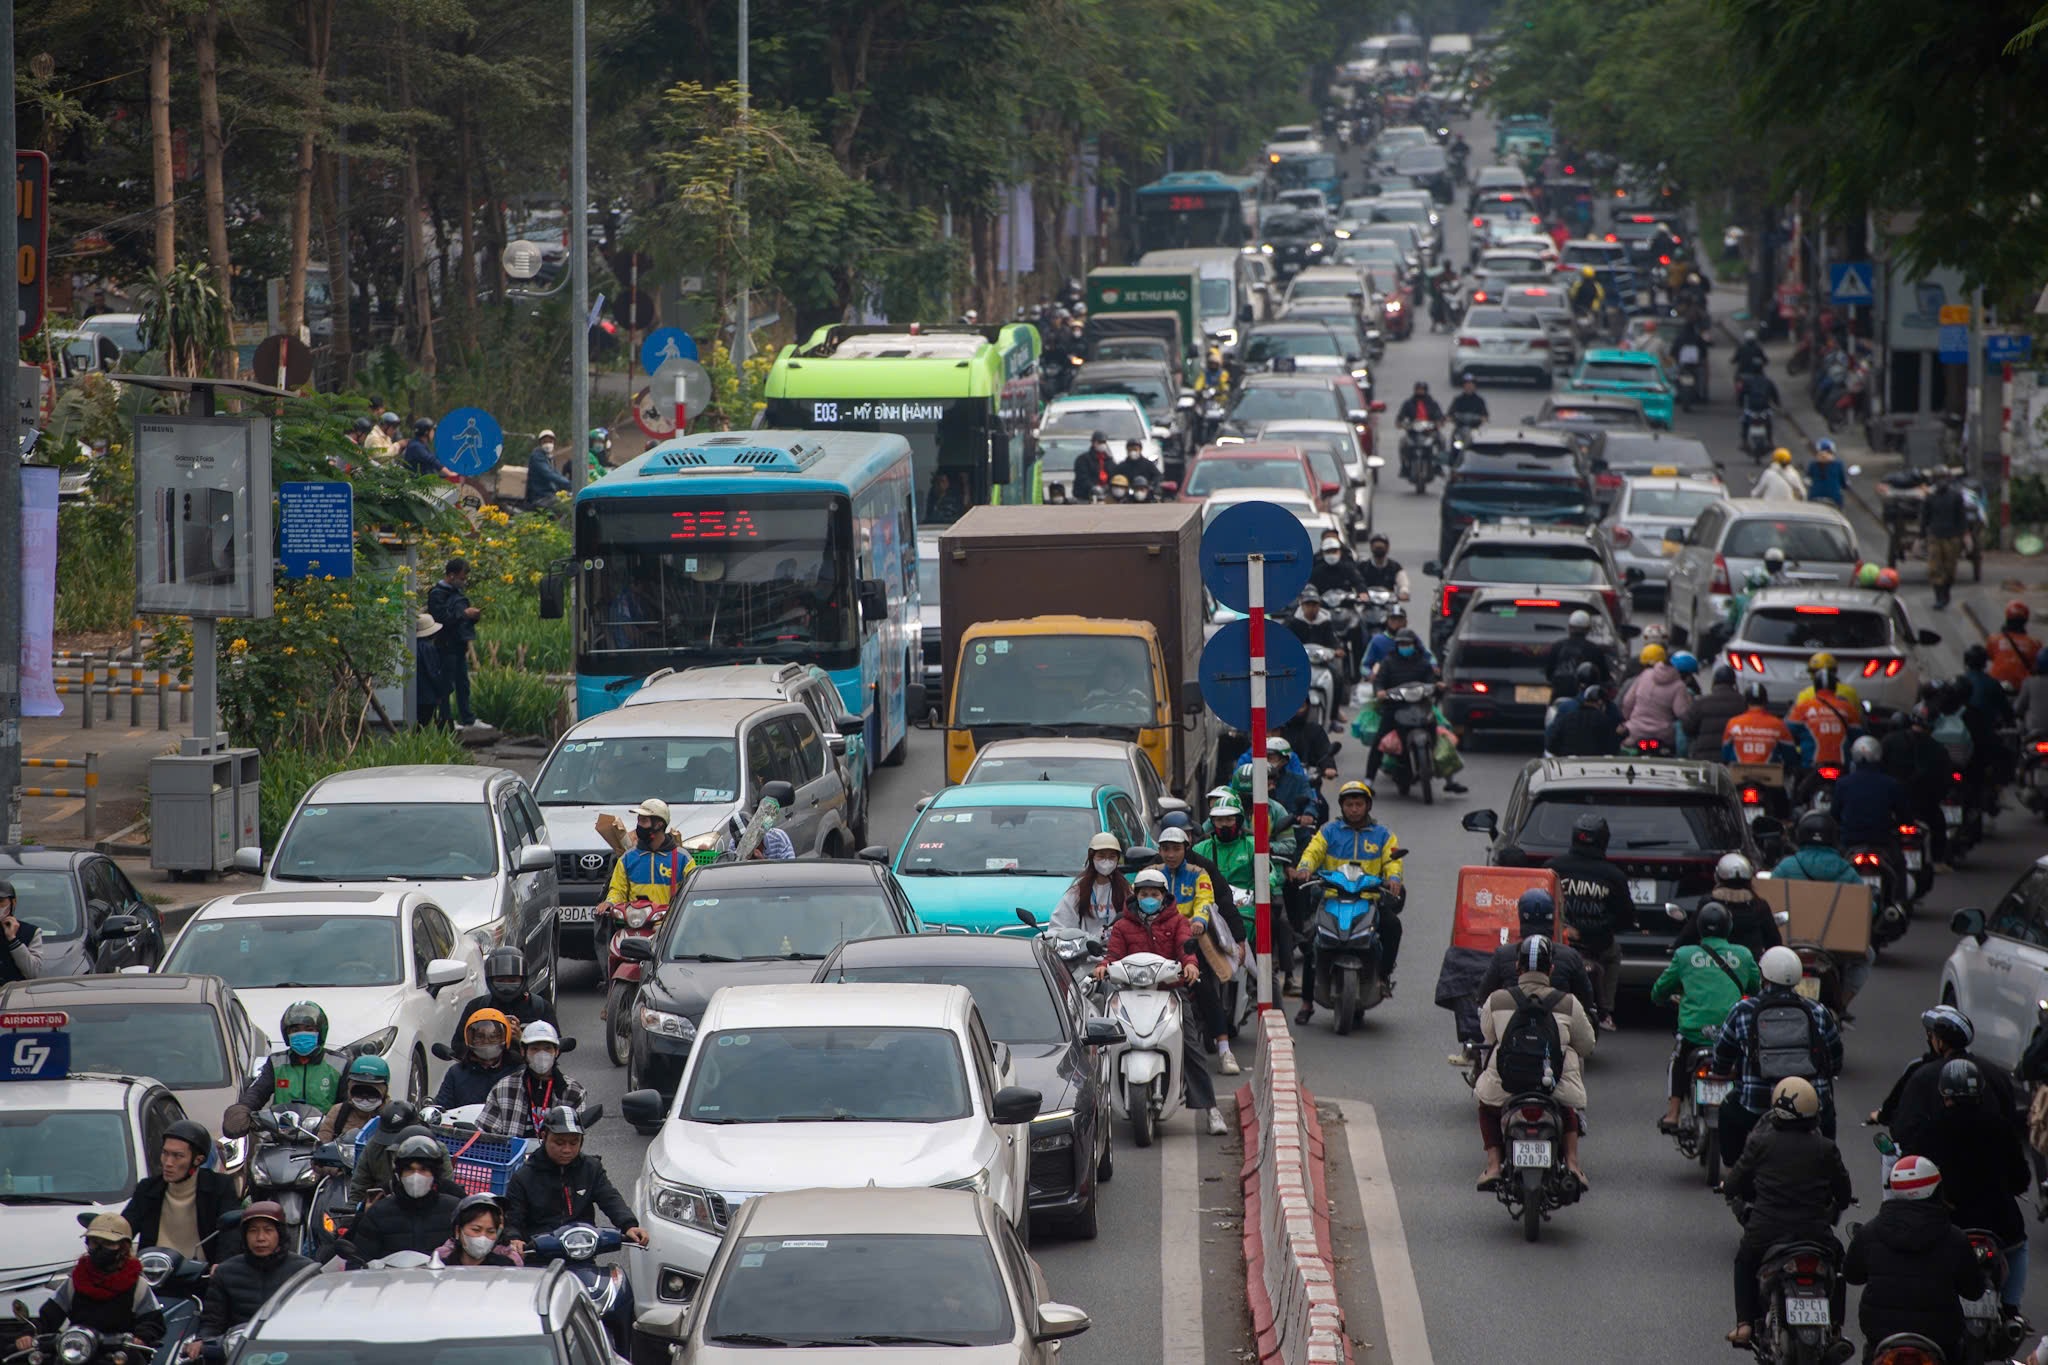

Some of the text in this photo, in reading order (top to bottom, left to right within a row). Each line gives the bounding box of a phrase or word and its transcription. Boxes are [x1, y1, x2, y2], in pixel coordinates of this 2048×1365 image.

[814, 403, 838, 421] E03
[854, 403, 872, 419] MỸ
[874, 403, 900, 419] ĐÌNH
[143, 425, 174, 433] SAMSUNG
[1364, 839, 1380, 853] be
[659, 863, 672, 878] be
[1181, 883, 1194, 896] be
[1494, 896, 1520, 907] Shop
[13, 1038, 51, 1074] G7
[1792, 1299, 1823, 1311] 29-C1
